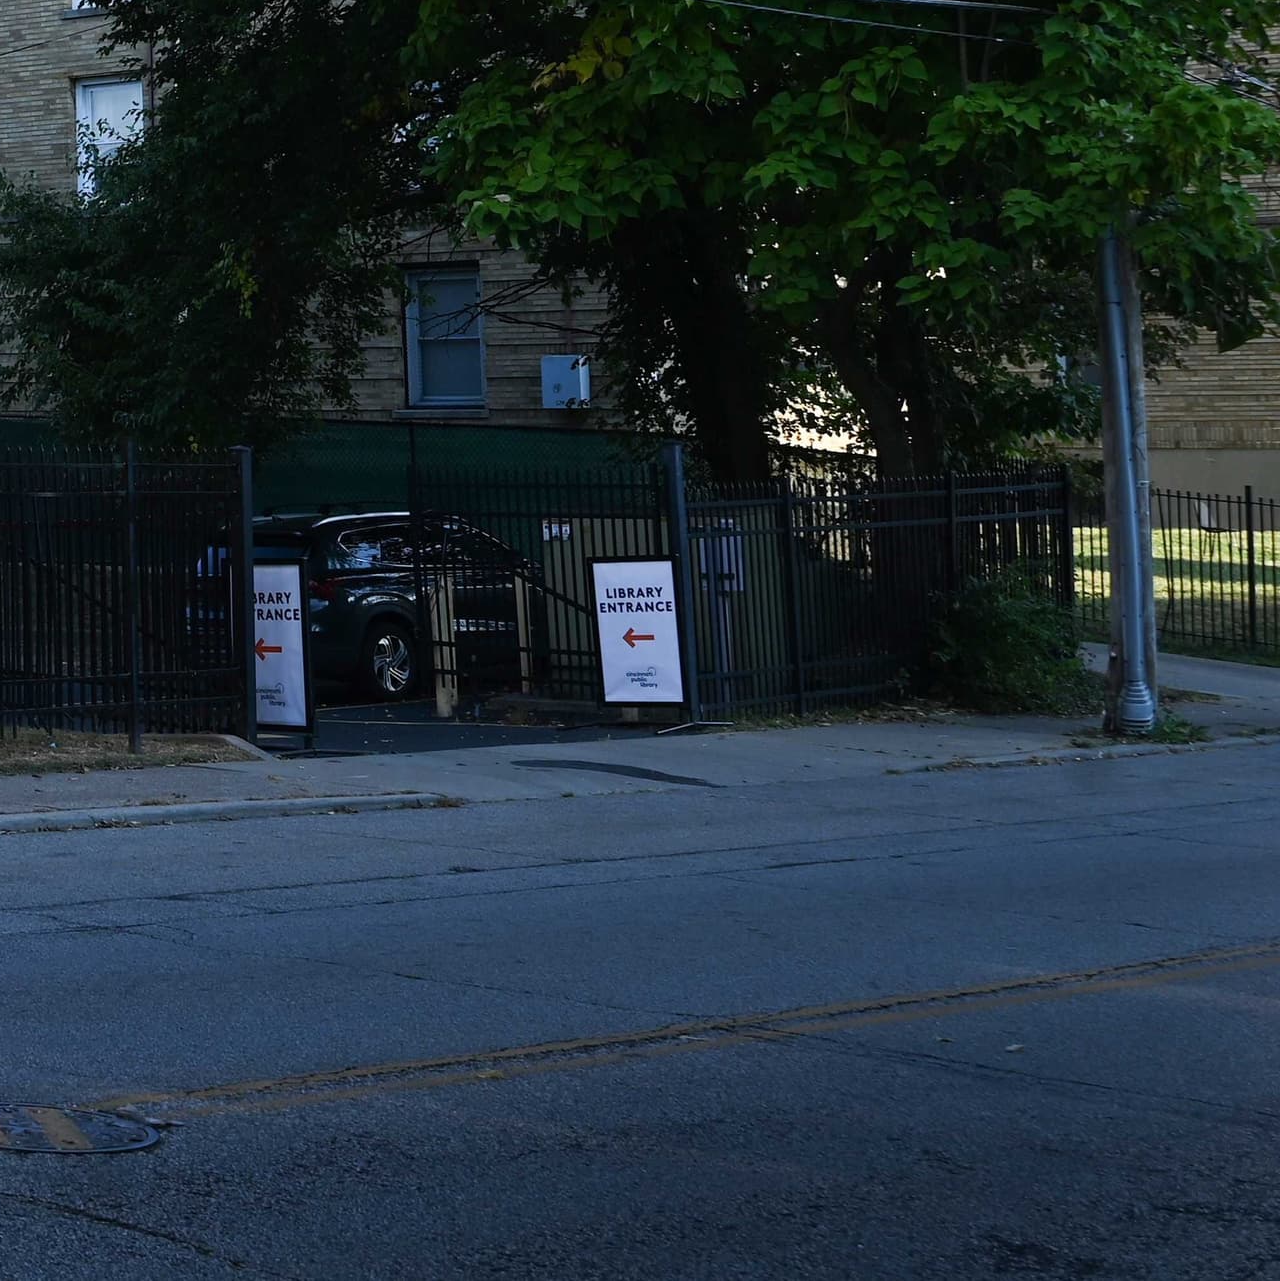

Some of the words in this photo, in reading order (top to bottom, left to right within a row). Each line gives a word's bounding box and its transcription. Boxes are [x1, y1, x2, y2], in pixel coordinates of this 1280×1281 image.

[253, 592, 291, 604] BRARY
[605, 587, 663, 599] LIBRARY
[599, 601, 673, 613] ENTRANCE
